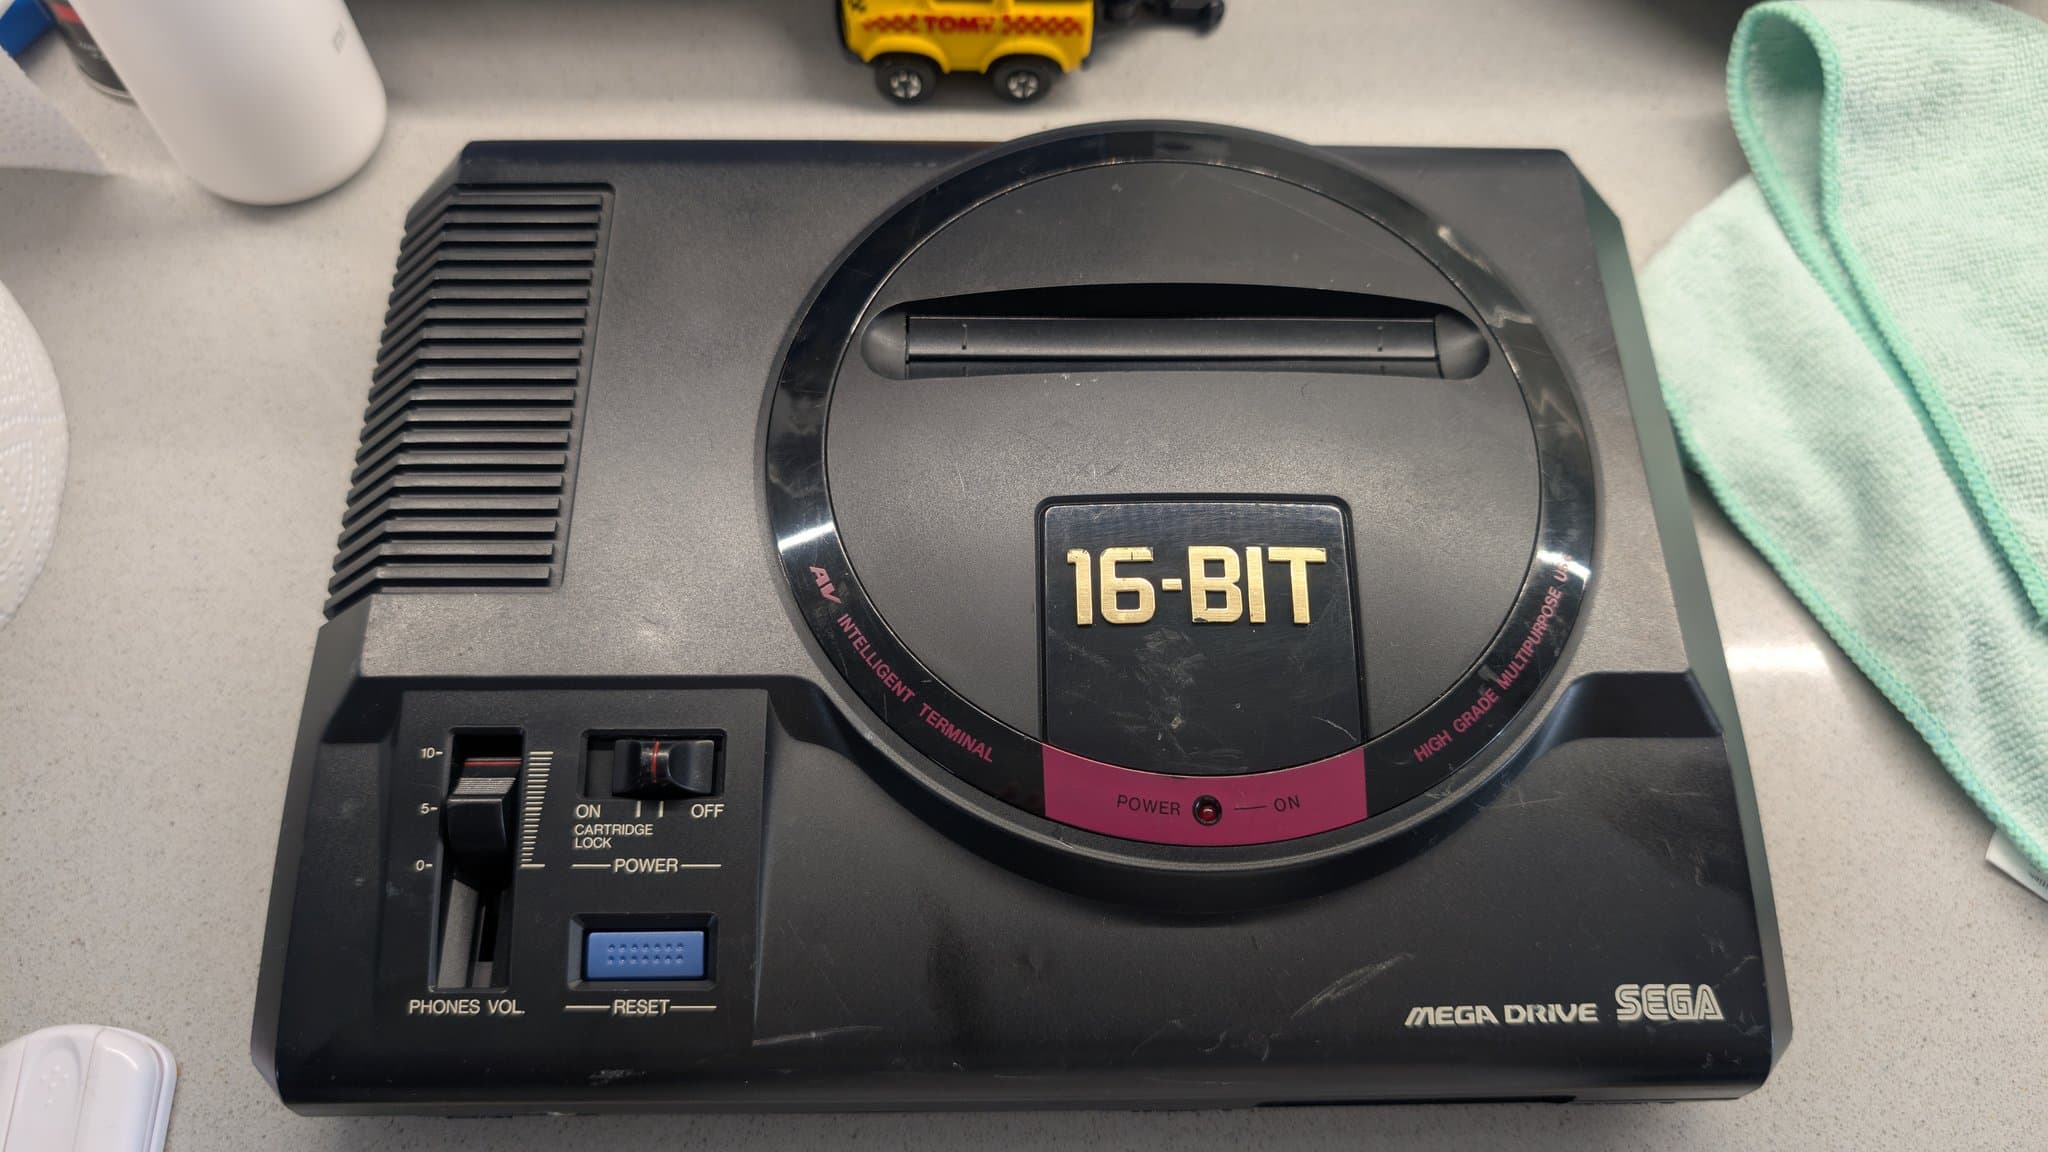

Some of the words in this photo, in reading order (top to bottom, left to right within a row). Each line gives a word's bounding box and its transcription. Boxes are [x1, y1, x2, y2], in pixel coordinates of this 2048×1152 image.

[924, 15, 994, 33] TOMY
[1066, 546, 1327, 625] 16-BIT
[809, 566, 842, 604] AV
[836, 613, 916, 703] INTELLIGENT
[917, 702, 993, 763] TERMINAL
[1412, 729, 1454, 763] HIGH
[1452, 687, 1500, 734] GRADE
[1496, 585, 1563, 690] MULTIPURPOSE
[575, 803, 602, 819] ON
[690, 803, 725, 819] OFF
[1116, 794, 1182, 816] POWER
[1273, 795, 1301, 813] ON
[573, 823, 655, 836] CARTRIDGE
[574, 836, 613, 849] LOCK
[613, 858, 679, 873] POWER
[408, 1000, 481, 1015] PHONES
[488, 1000, 526, 1015] VOL.
[613, 1000, 671, 1015] RESET
[1614, 983, 1725, 1022] SEGA
[1403, 1005, 1501, 1027] MEGA
[1503, 1003, 1601, 1024] DRIVE
